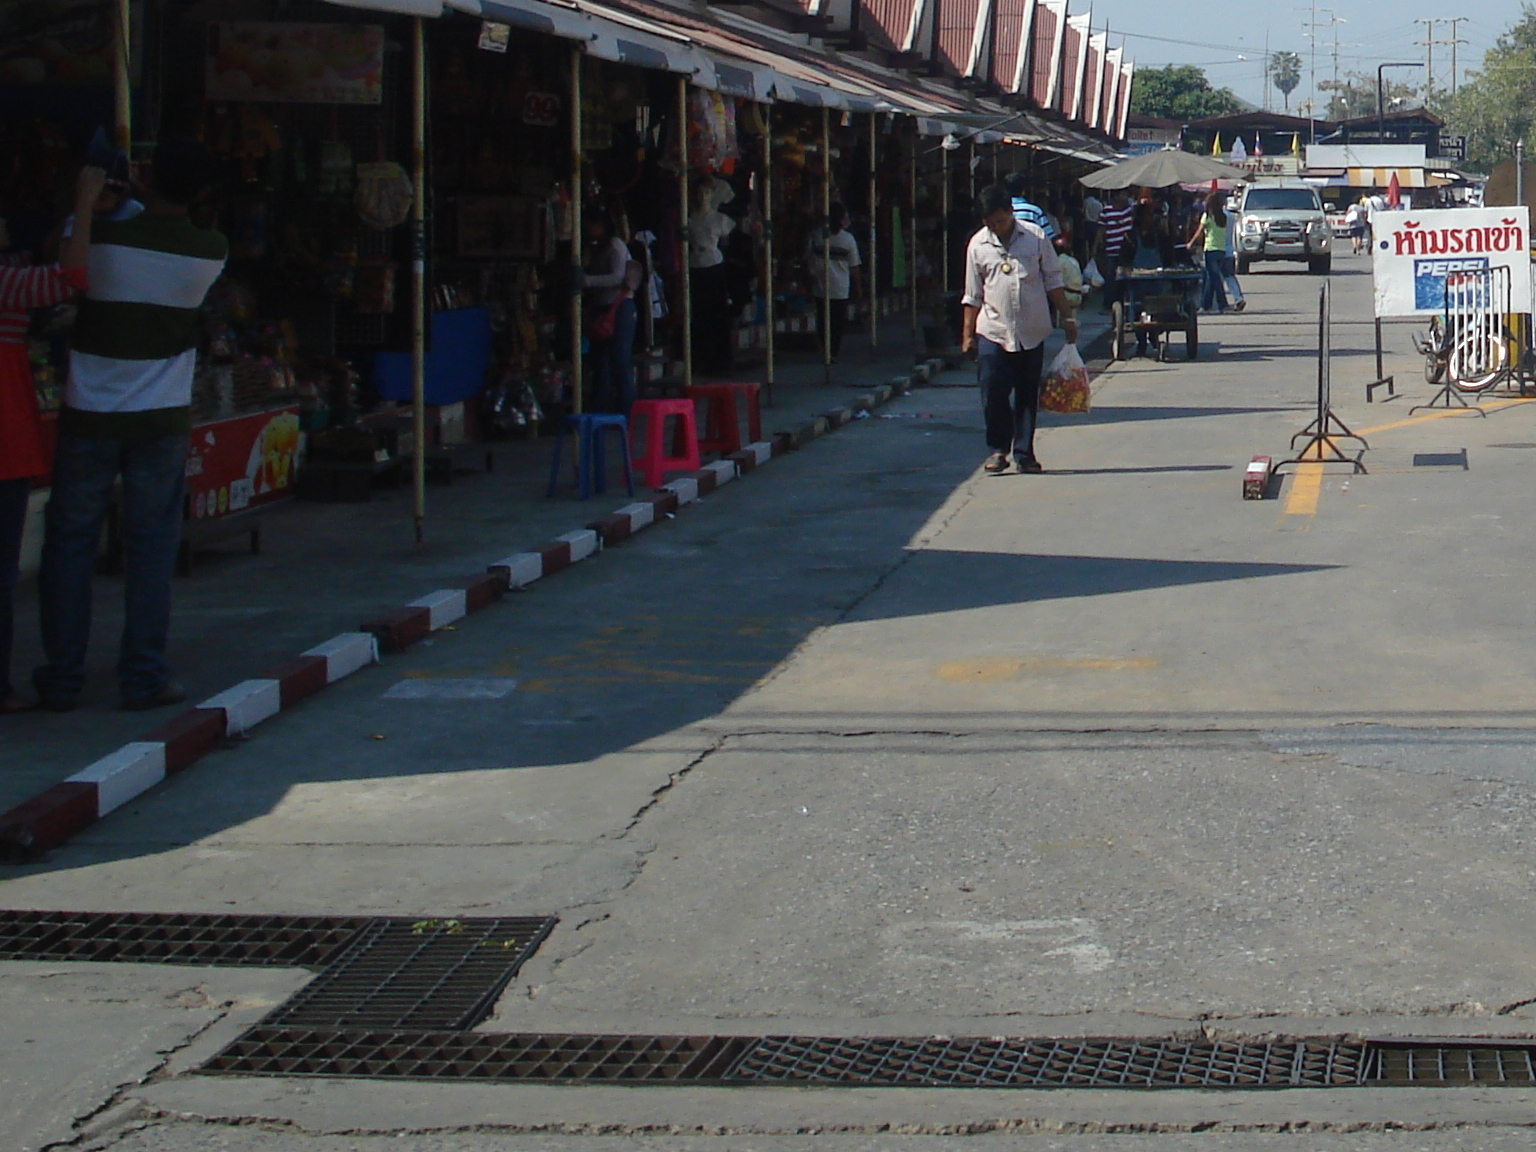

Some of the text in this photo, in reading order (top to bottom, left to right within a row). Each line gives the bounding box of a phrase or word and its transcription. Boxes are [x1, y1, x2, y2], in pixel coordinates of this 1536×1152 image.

[1393, 217, 1523, 255] ห้ามรถเข้า
[1416, 260, 1485, 277] PEPSI
